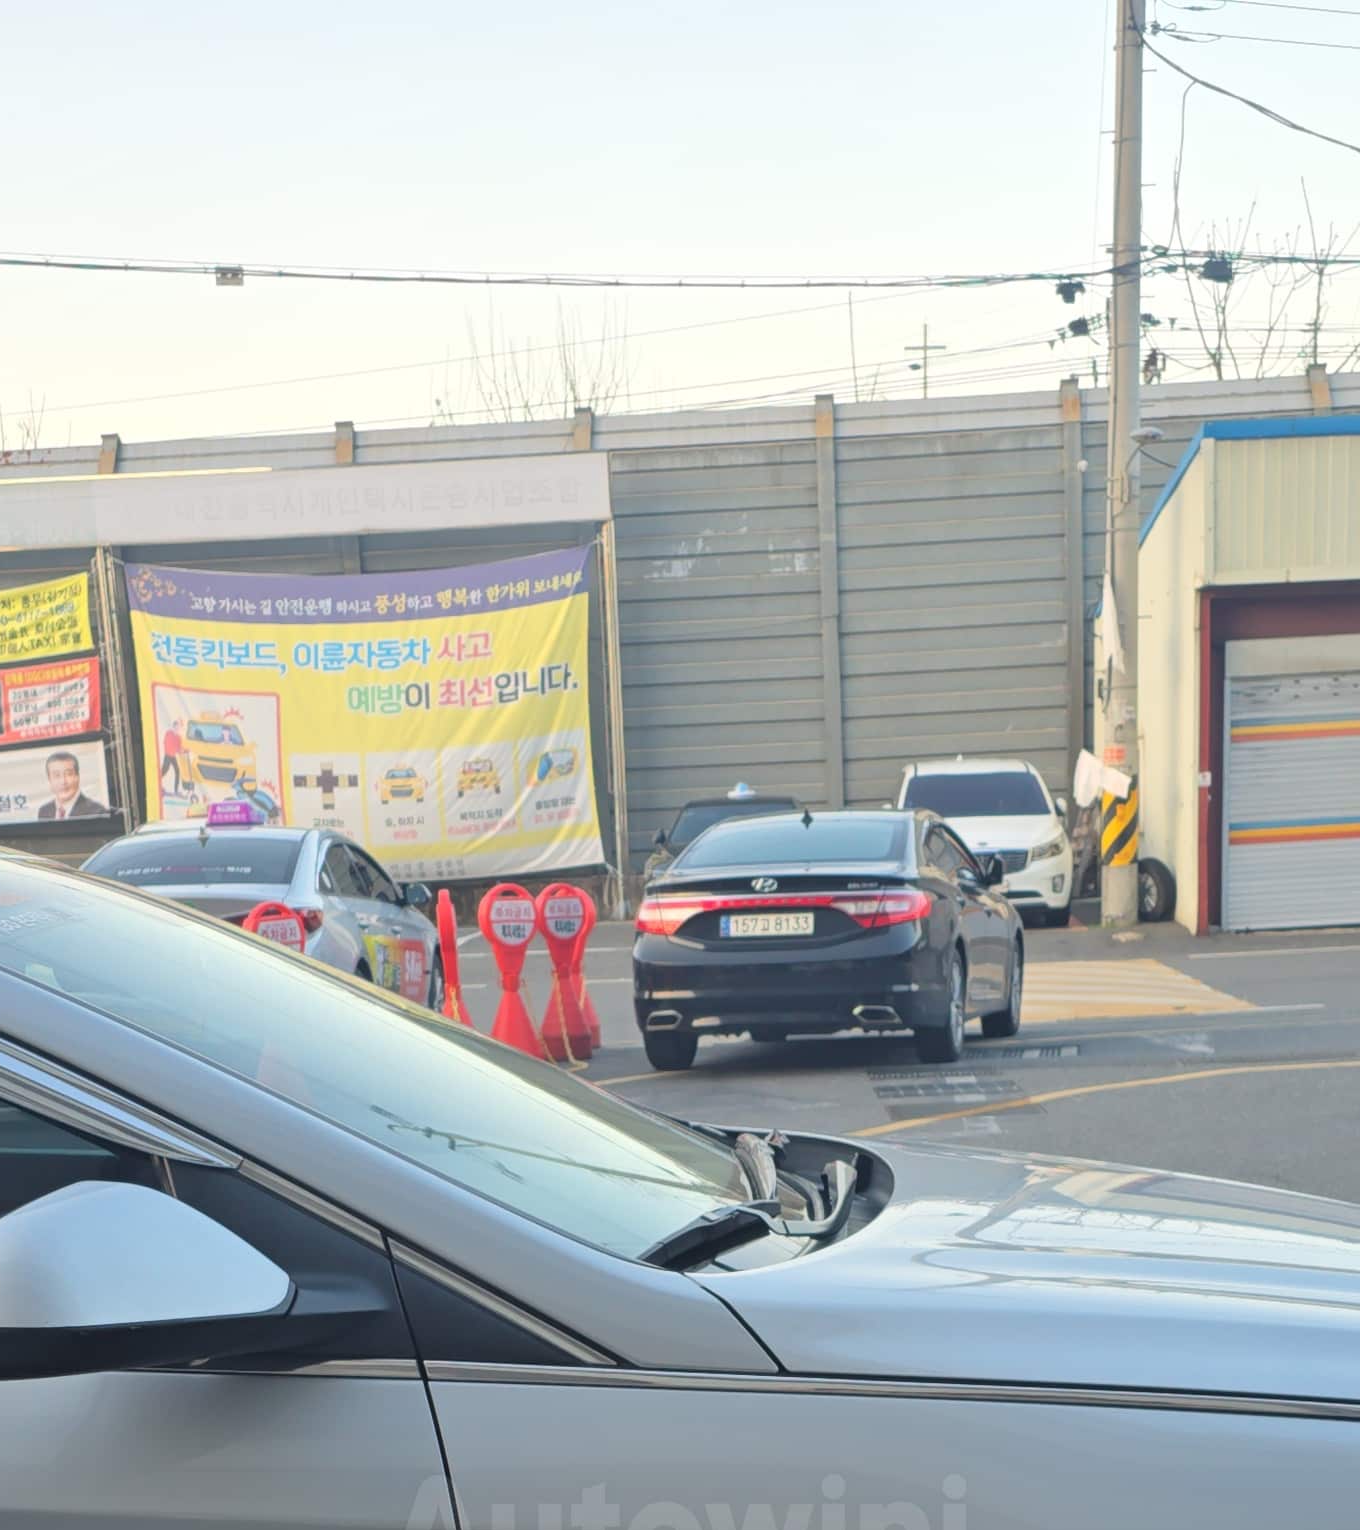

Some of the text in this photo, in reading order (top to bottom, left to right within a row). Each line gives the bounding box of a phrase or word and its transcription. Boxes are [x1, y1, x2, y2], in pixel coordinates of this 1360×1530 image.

[276, 598, 332, 616] 안전운행
[294, 638, 430, 670] 이륜자동차
[437, 633, 492, 661] 사고
[348, 663, 579, 714] 예방이 최선입니다.
[775, 916, 809, 931] 8133
